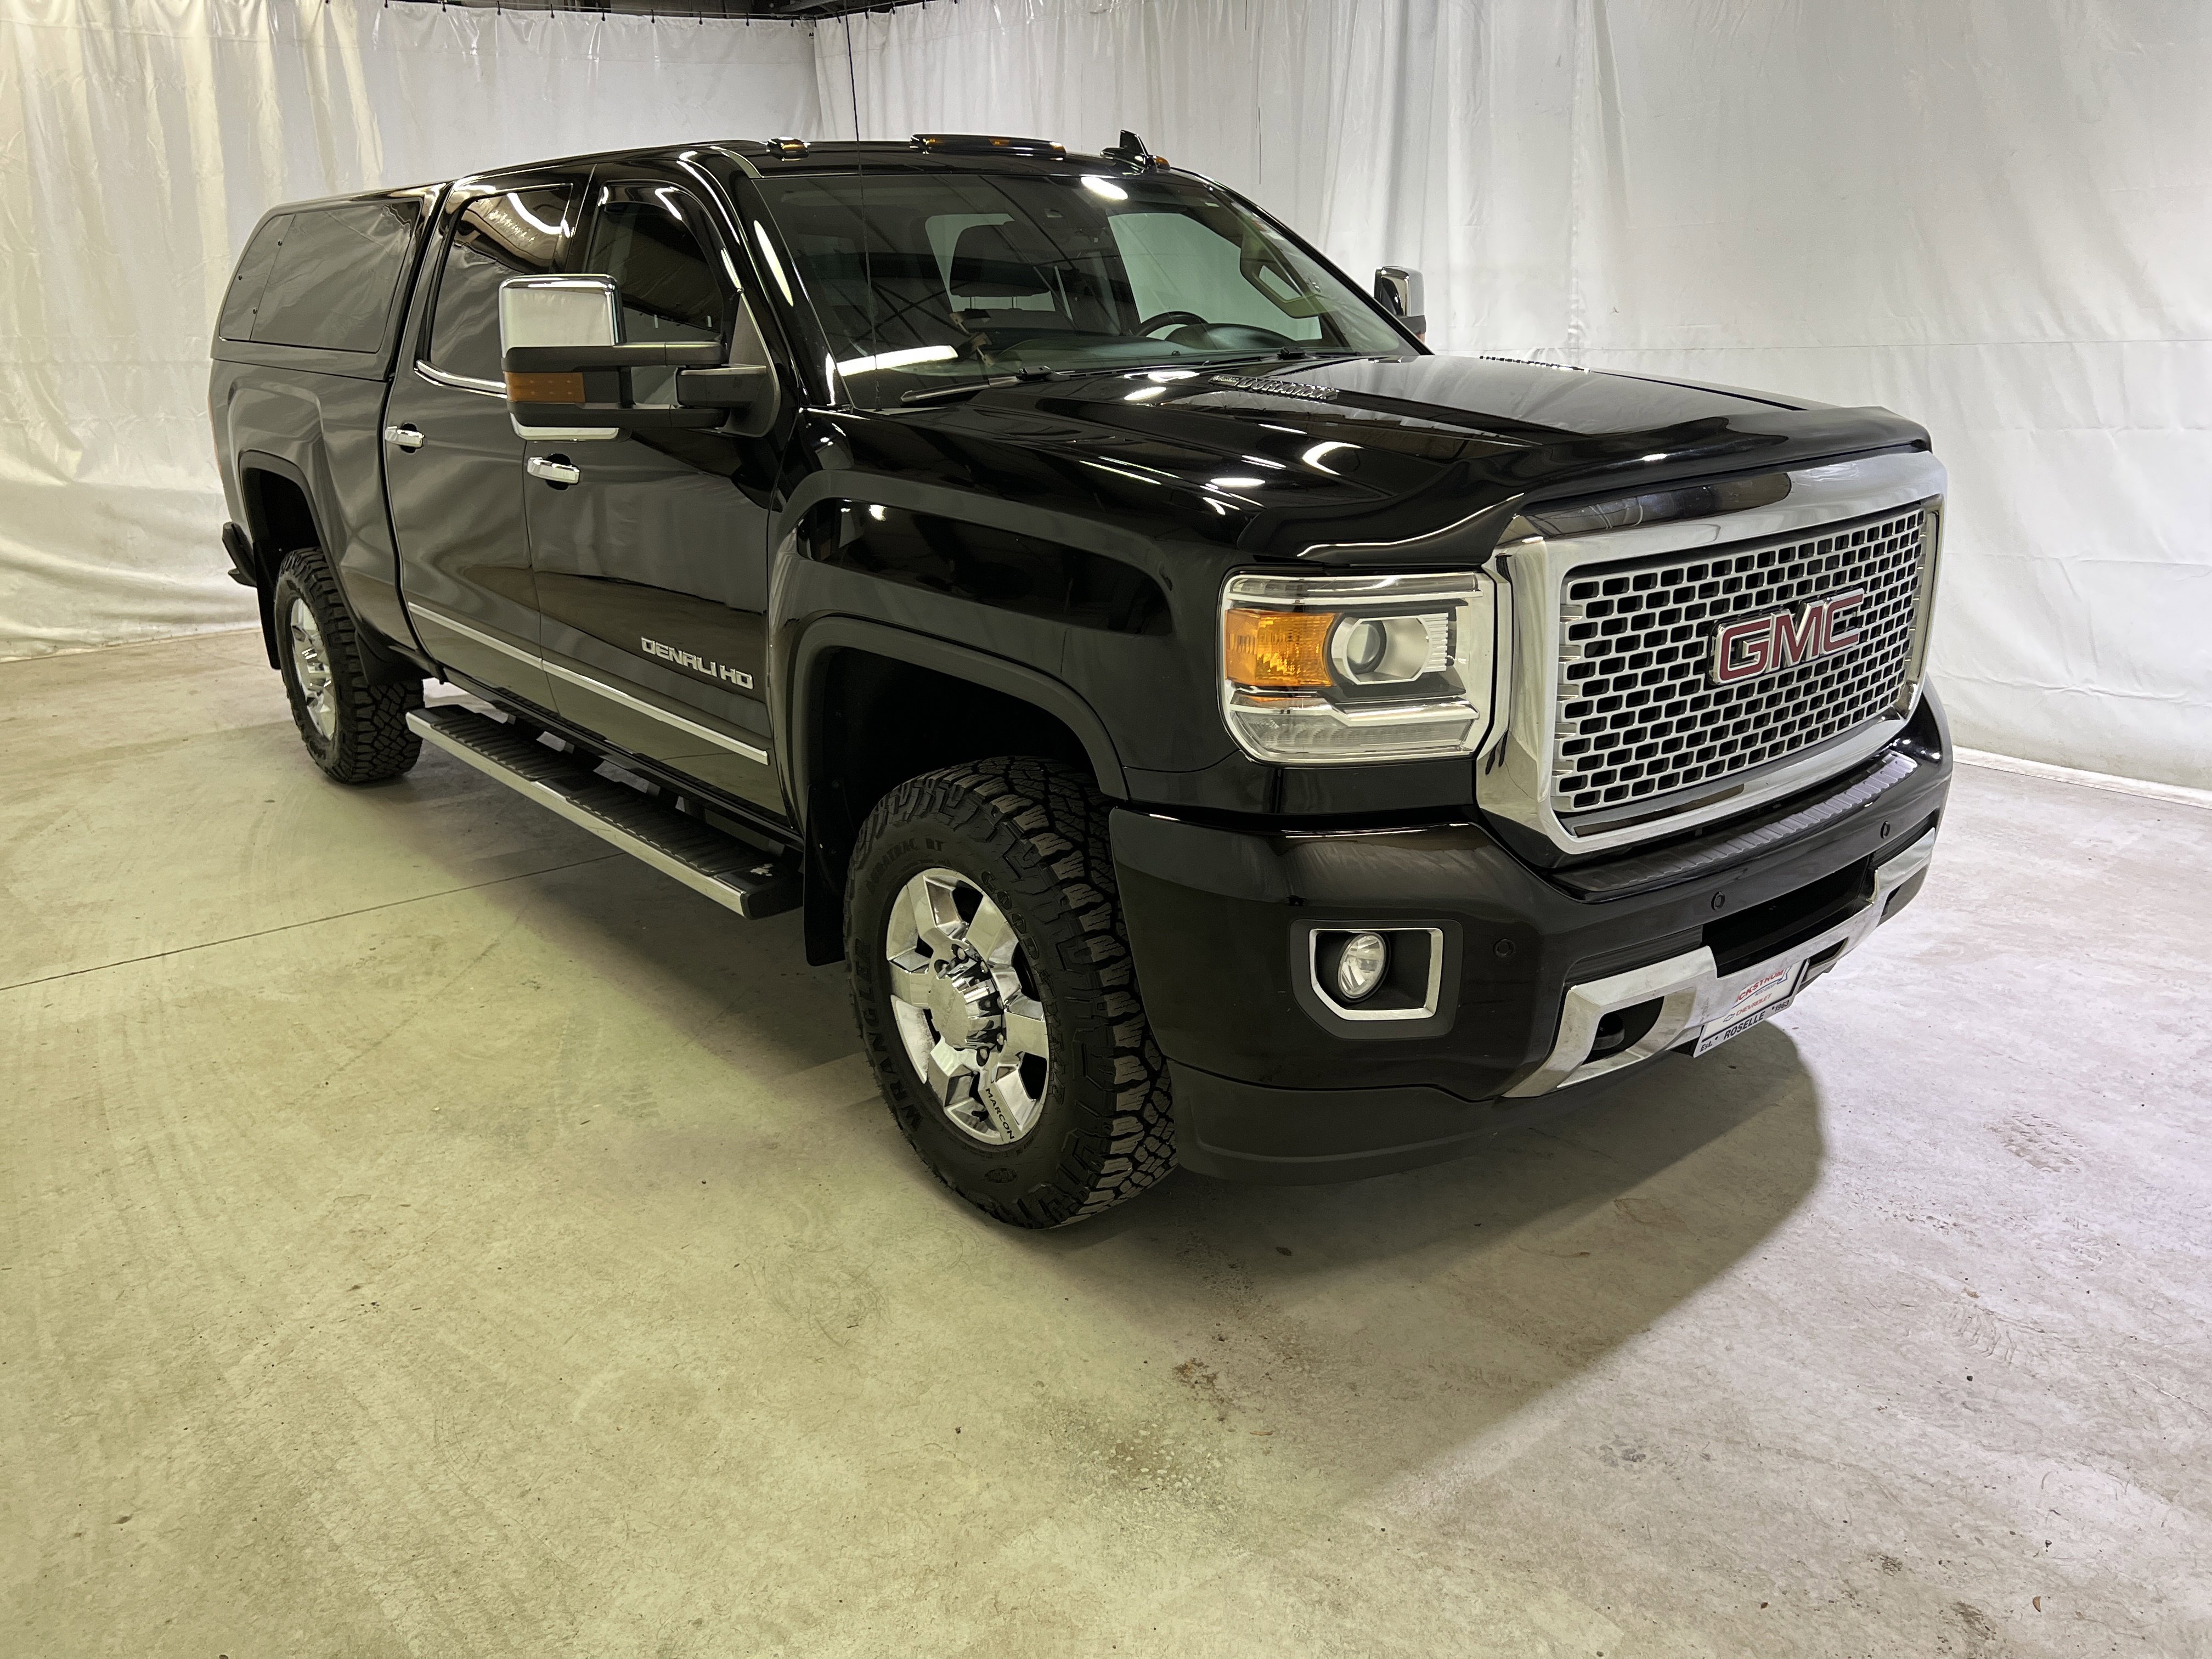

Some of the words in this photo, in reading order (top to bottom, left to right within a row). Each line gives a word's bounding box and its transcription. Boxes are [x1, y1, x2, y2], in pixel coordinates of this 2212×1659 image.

[1713, 588, 1865, 684] GMC
[641, 636, 717, 677] DENALI
[719, 665, 754, 690] HD
[1723, 1011, 1766, 1040] ROSELLE
[1735, 993, 1773, 1017] CHEVROLET
[855, 938, 923, 1132] WRANGLER
[985, 1088, 1015, 1139] MARCON
